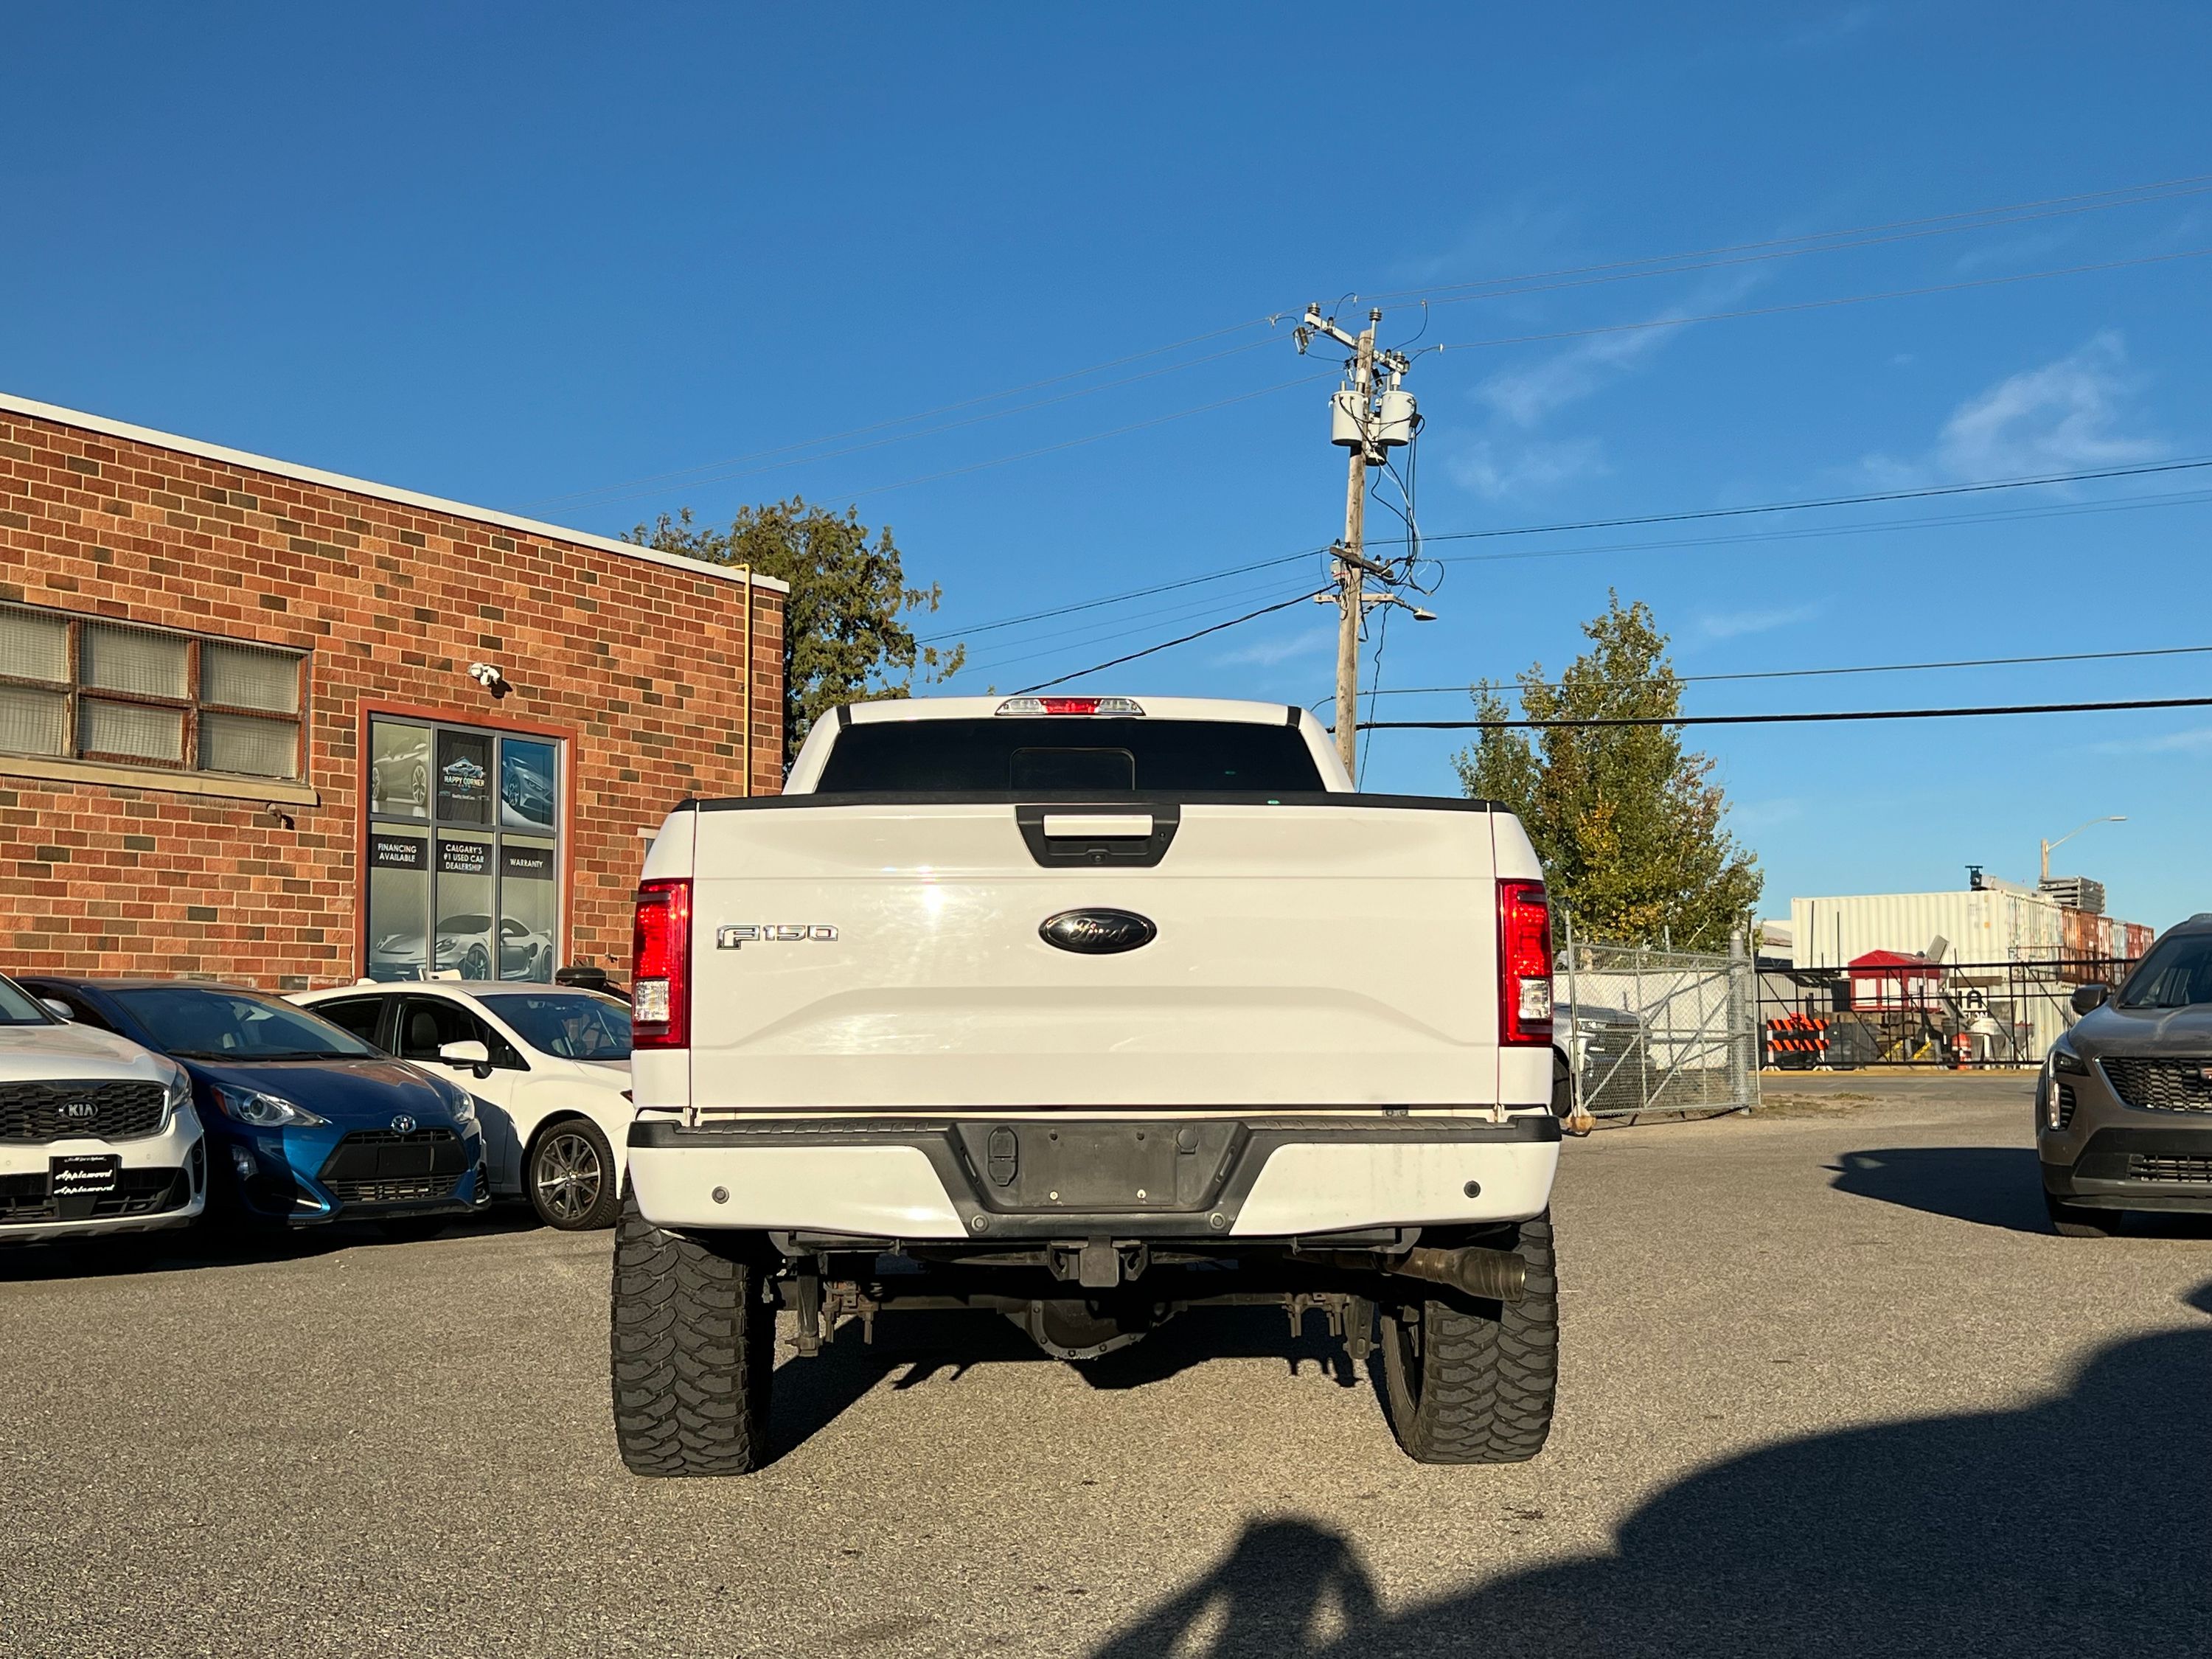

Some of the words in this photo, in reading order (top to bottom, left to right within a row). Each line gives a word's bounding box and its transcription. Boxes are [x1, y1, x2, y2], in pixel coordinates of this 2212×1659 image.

[444, 776, 462, 785] HAPPY
[463, 778, 484, 787] CORNER
[378, 843, 417, 854] FINANCING
[445, 844, 482, 855] CALGARY'S
[378, 852, 415, 863] AVAILABLE
[509, 858, 543, 868] WARRANTY
[445, 862, 482, 872] DEALERSHIP
[1068, 917, 1130, 944] Ford
[68, 1104, 94, 1116] KIA
[55, 1169, 113, 1181] Applewood
